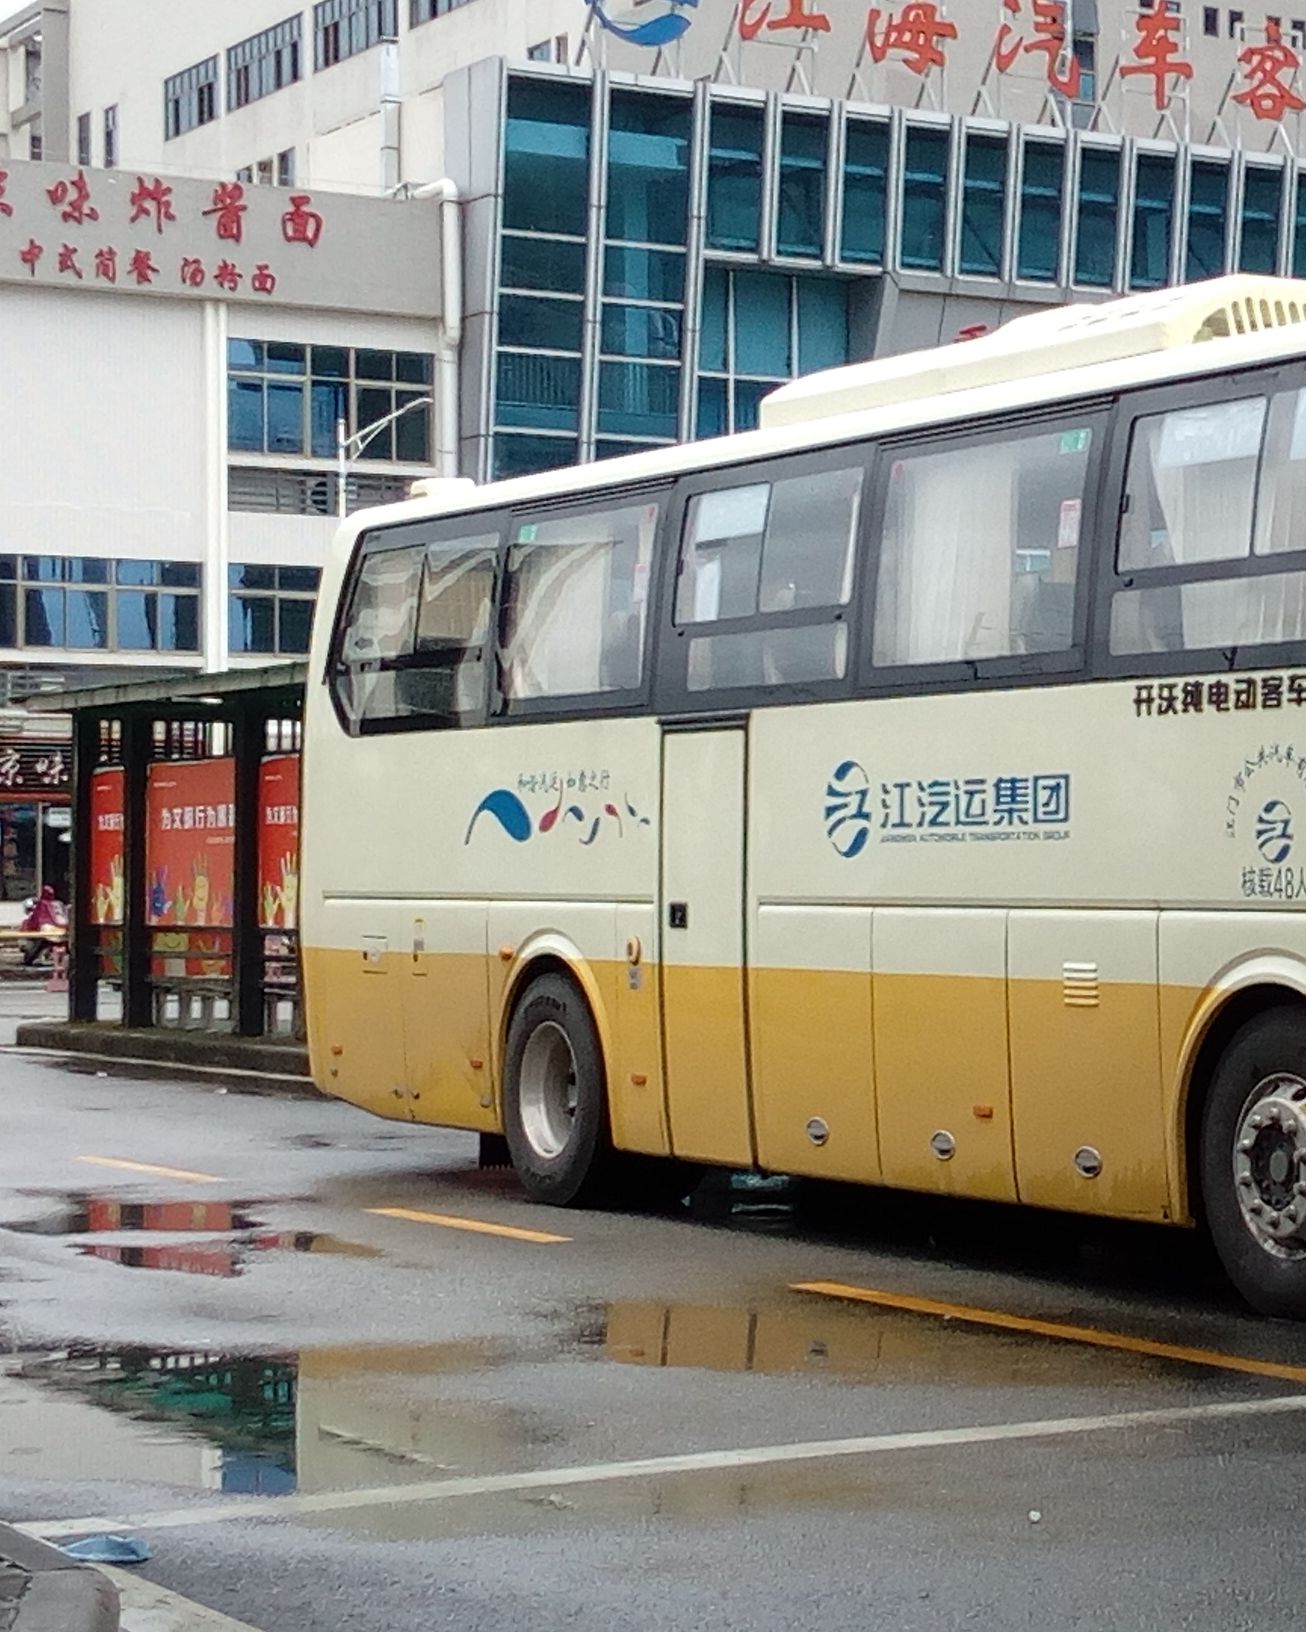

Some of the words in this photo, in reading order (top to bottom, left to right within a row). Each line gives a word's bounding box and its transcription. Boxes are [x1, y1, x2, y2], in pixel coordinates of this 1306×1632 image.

[0, 169, 323, 248] 味炸酱面
[20, 238, 160, 286] 中式简餐
[180, 257, 276, 296] 汤粉面
[880, 774, 1070, 829] 江汽运集团
